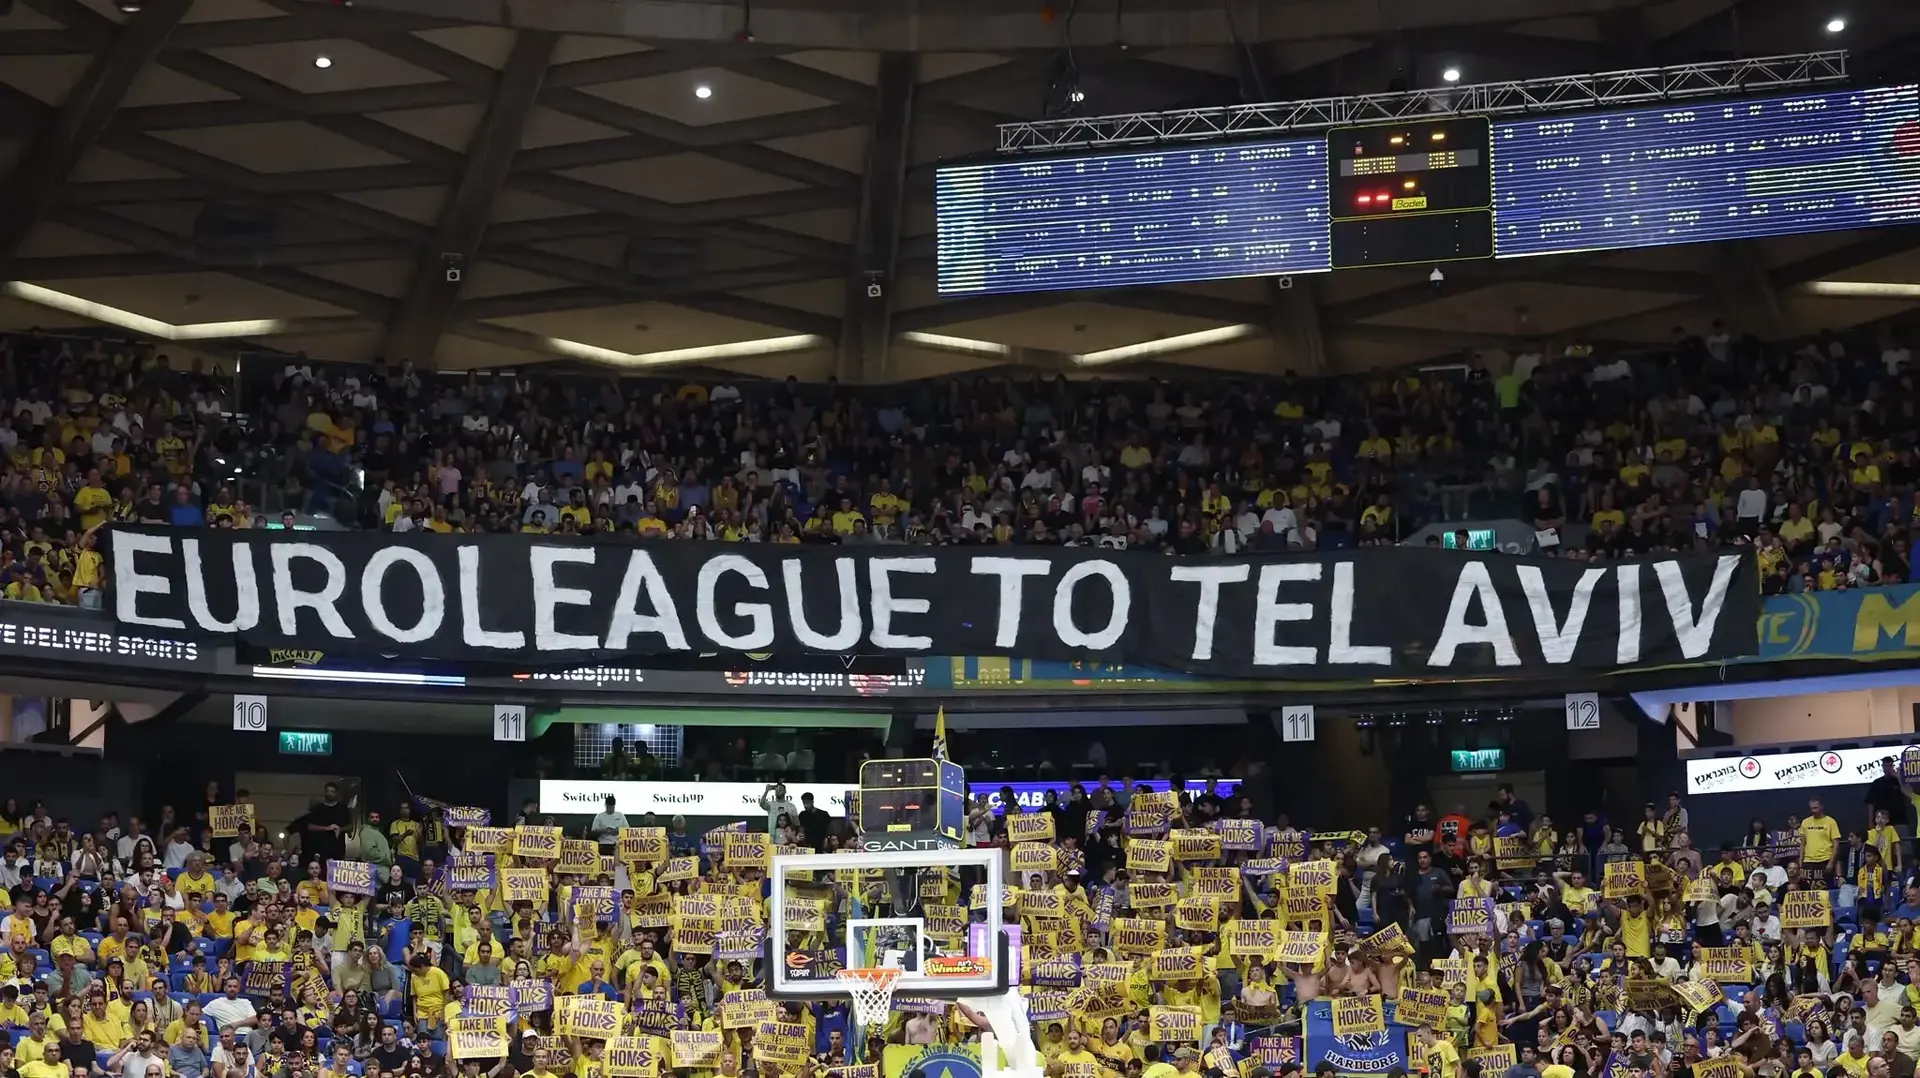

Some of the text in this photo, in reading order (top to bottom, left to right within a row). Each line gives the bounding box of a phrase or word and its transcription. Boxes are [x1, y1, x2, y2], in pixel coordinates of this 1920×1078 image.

[1395, 199, 1425, 208] Bodet
[112, 530, 1741, 666] EUROLEAGUE TO TEL AVIV
[24, 627, 111, 652] DELIVER
[118, 636, 197, 660] SPORTS
[236, 702, 265, 728] 10
[1568, 701, 1598, 727] 12
[500, 713, 521, 739] 11
[1287, 713, 1310, 739] 11
[298, 734, 328, 752] יציאה
[1471, 750, 1500, 768] יציאה
[1695, 766, 1736, 785] בורגראנץ
[1775, 760, 1817, 780] בורגראנץ
[653, 793, 703, 803] Switchup
[1141, 794, 1157, 803] TAKE
[626, 829, 658, 837] TAKE ME
[732, 834, 762, 842] TAKE ME
[1273, 833, 1302, 842] TAKE ME
[579, 841, 592, 850] ME
[864, 840, 936, 851] GANT
[336, 860, 369, 872] TAKE ME
[453, 856, 487, 866] TAKE ME
[1611, 862, 1636, 872] TAKE ME
[1200, 868, 1231, 878] TAKE ME
[579, 888, 612, 898] TAKE ME
[708, 884, 739, 894] TAKE ME
[1287, 886, 1318, 897] TAKE ME
[1788, 891, 1820, 902] TAKE ME
[1454, 898, 1486, 909] TAKE ME
[741, 907, 752, 916] ME
[929, 906, 960, 917] TAKE ME
[682, 920, 715, 930] TAKE ME
[1038, 919, 1071, 931] TAKE ME
[1123, 919, 1156, 931] TAKE ME
[1237, 921, 1271, 931] TAKE ME
[1287, 932, 1319, 942] TAKE ME
[1375, 925, 1399, 946] LEAGUE
[1709, 949, 1742, 959] TAKE ME
[253, 962, 283, 972] TAKE ME
[932, 964, 972, 973] Winner
[533, 979, 545, 987] ME
[472, 986, 509, 997] TAKE ME
[726, 991, 767, 1003] ONE LEAGU
[1339, 995, 1372, 1008] TAKE ME
[1402, 989, 1446, 1006] ONE LEAGUE
[578, 1001, 615, 1013] TAKE ME
[644, 1000, 678, 1014] TAKE ME
[459, 1018, 498, 1030] TAKE ME
[761, 1023, 806, 1037] ONE LEAGUE
[675, 1032, 719, 1043] ONE LEAGUE
[1259, 1037, 1293, 1047] TAKE ME
[614, 1038, 649, 1049] TAKE ME
[920, 1046, 973, 1057] YELLOW ARMY
[1325, 1050, 1399, 1071] HARDCORE
[847, 1066, 876, 1078] LEAGUE
[1081, 1063, 1095, 1074] ME
